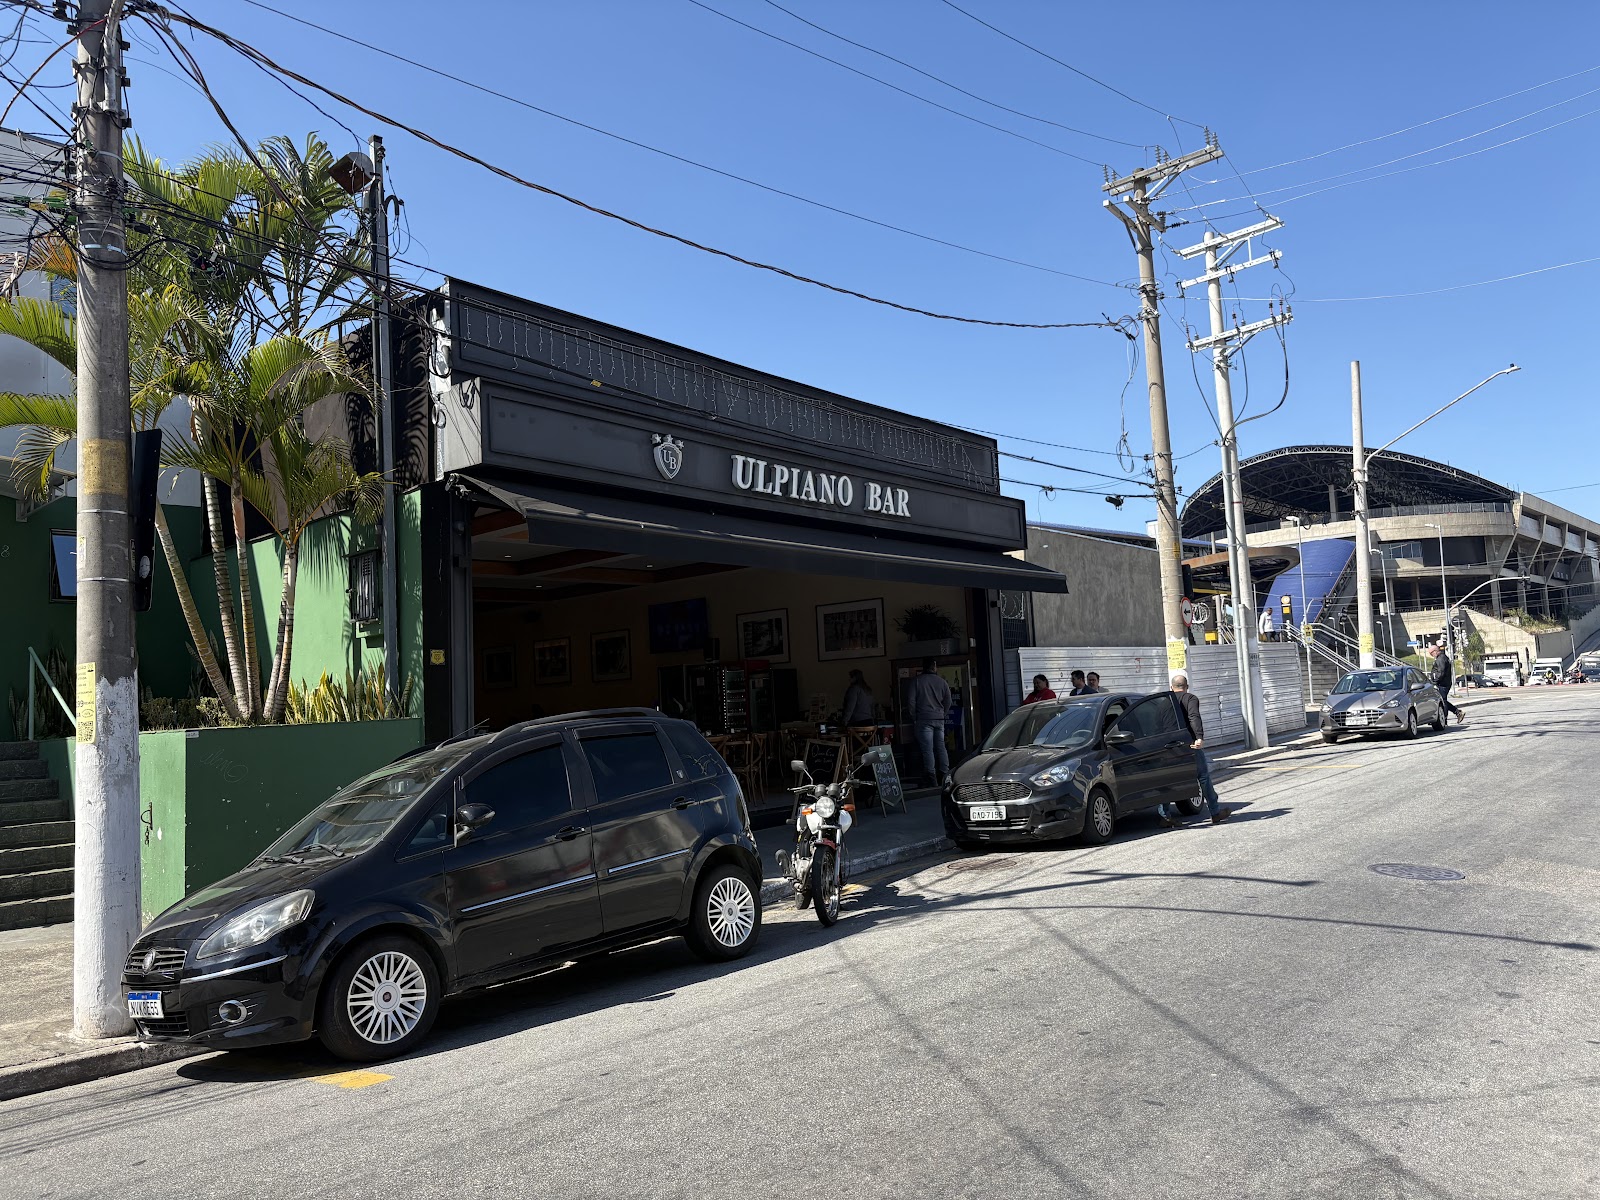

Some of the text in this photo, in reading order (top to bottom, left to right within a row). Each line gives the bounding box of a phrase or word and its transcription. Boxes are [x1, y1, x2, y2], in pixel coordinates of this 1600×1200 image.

[662, 449, 677, 470] UB
[731, 454, 911, 517] ULPIANO BAR
